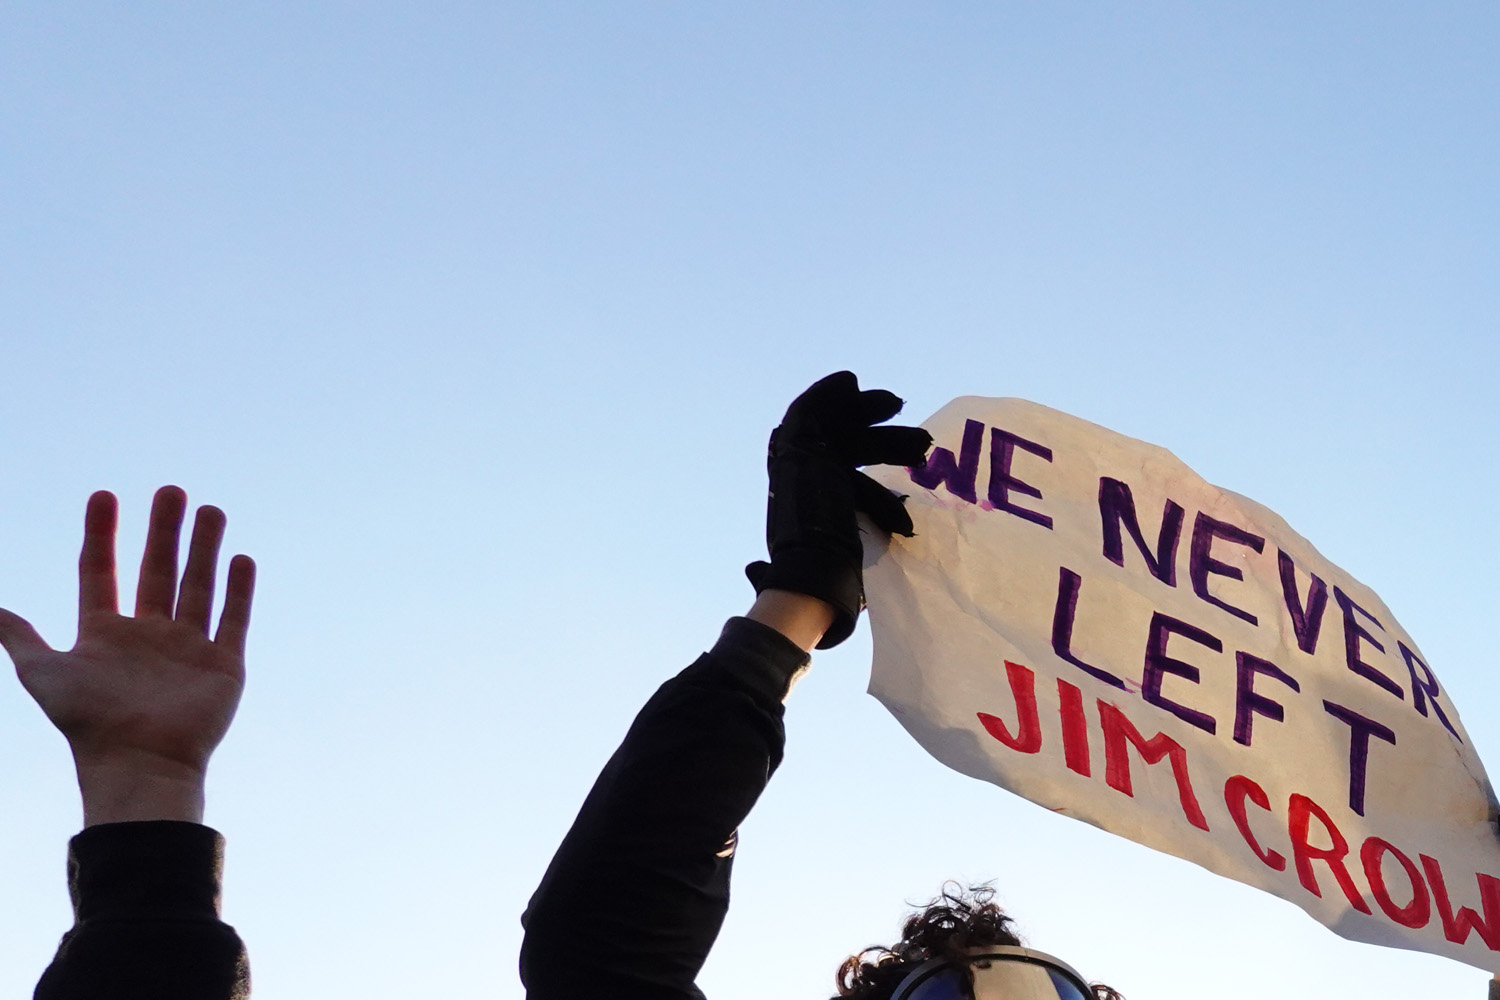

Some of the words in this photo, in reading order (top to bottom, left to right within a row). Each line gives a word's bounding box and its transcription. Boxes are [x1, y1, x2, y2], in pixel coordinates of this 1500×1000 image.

[906, 419, 1053, 530] WE
[1098, 476, 1462, 744] NEVER
[1051, 566, 1396, 817] LEFT
[976, 659, 1210, 832] JIM
